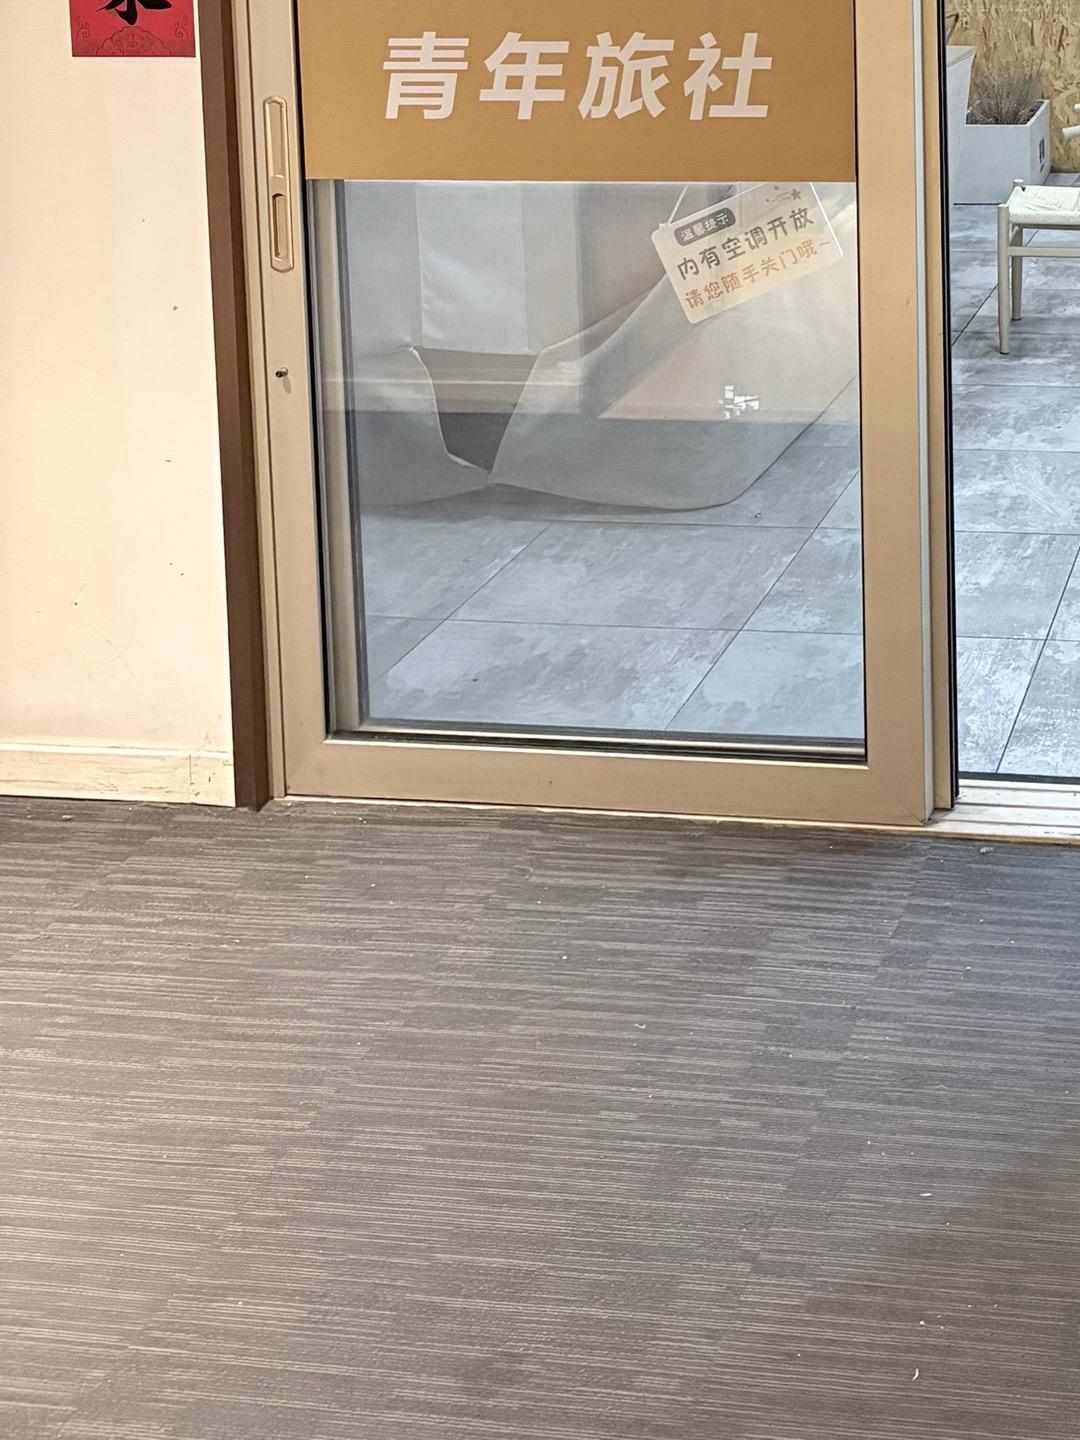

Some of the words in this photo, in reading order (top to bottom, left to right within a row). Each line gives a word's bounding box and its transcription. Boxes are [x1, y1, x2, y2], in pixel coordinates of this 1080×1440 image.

[383, 31, 773, 120] 青年旅社
[677, 207, 815, 281] 内有空调开放
